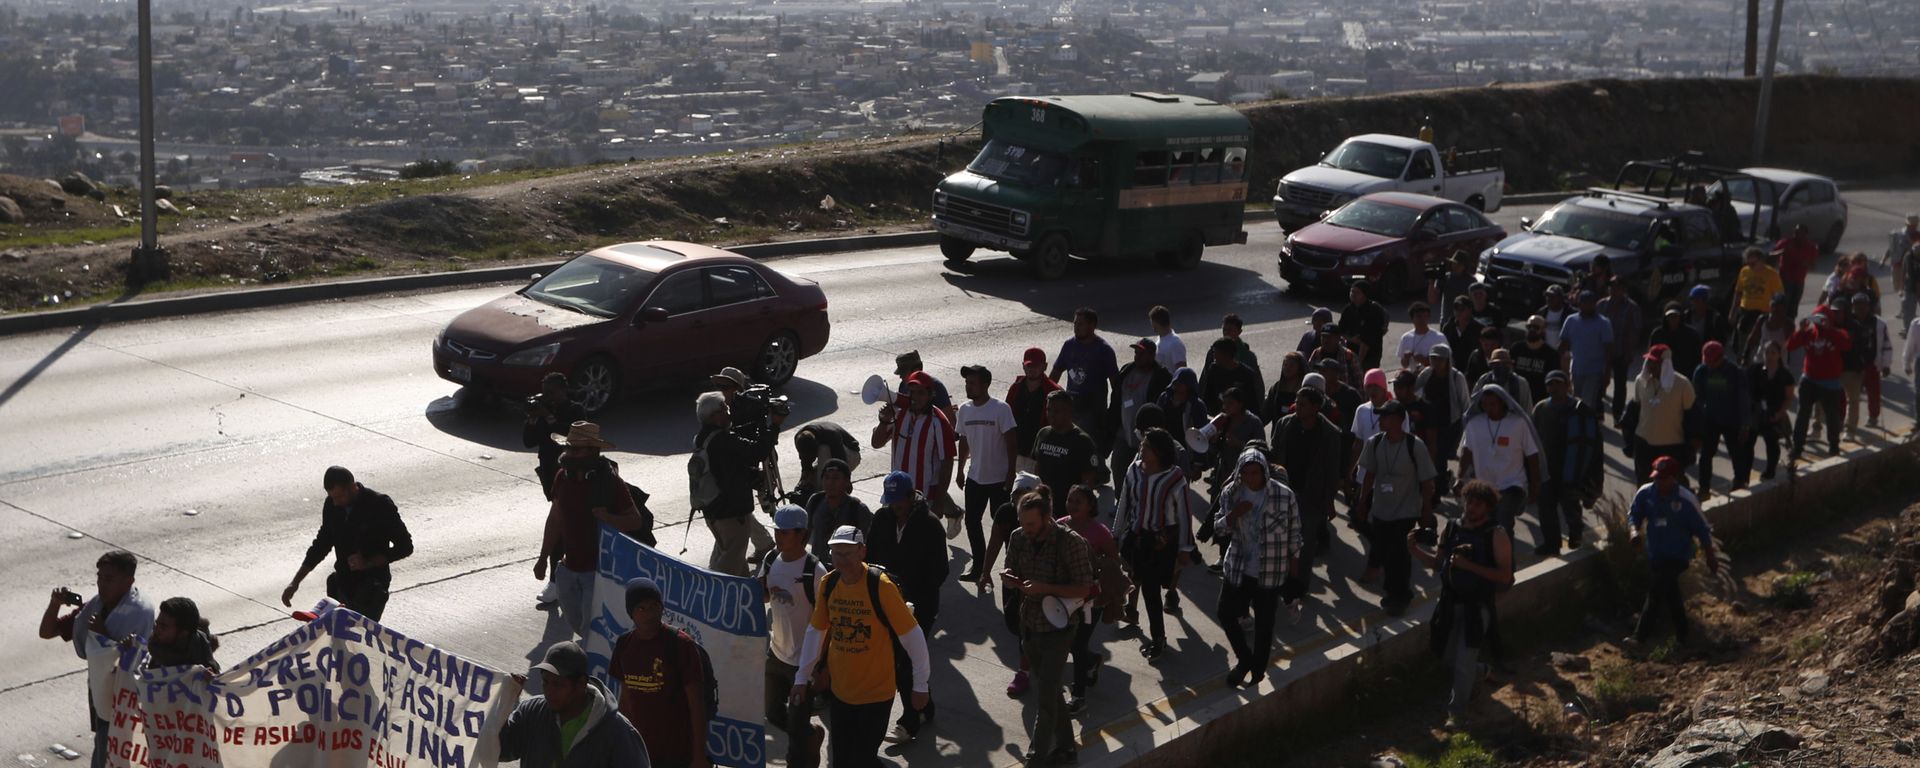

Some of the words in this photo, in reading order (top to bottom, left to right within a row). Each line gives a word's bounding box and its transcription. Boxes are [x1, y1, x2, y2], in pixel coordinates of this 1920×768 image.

[1031, 108, 1046, 124] 368
[600, 529, 623, 580] EL
[636, 550, 757, 632] SALVADOR
[241, 646, 370, 688] DERECHO
[383, 662, 398, 700] DE
[400, 678, 486, 739] ASILO
[223, 726, 245, 746] DE
[254, 723, 316, 746] ASILO
[331, 728, 363, 751] LOS
[708, 720, 761, 765] 503
